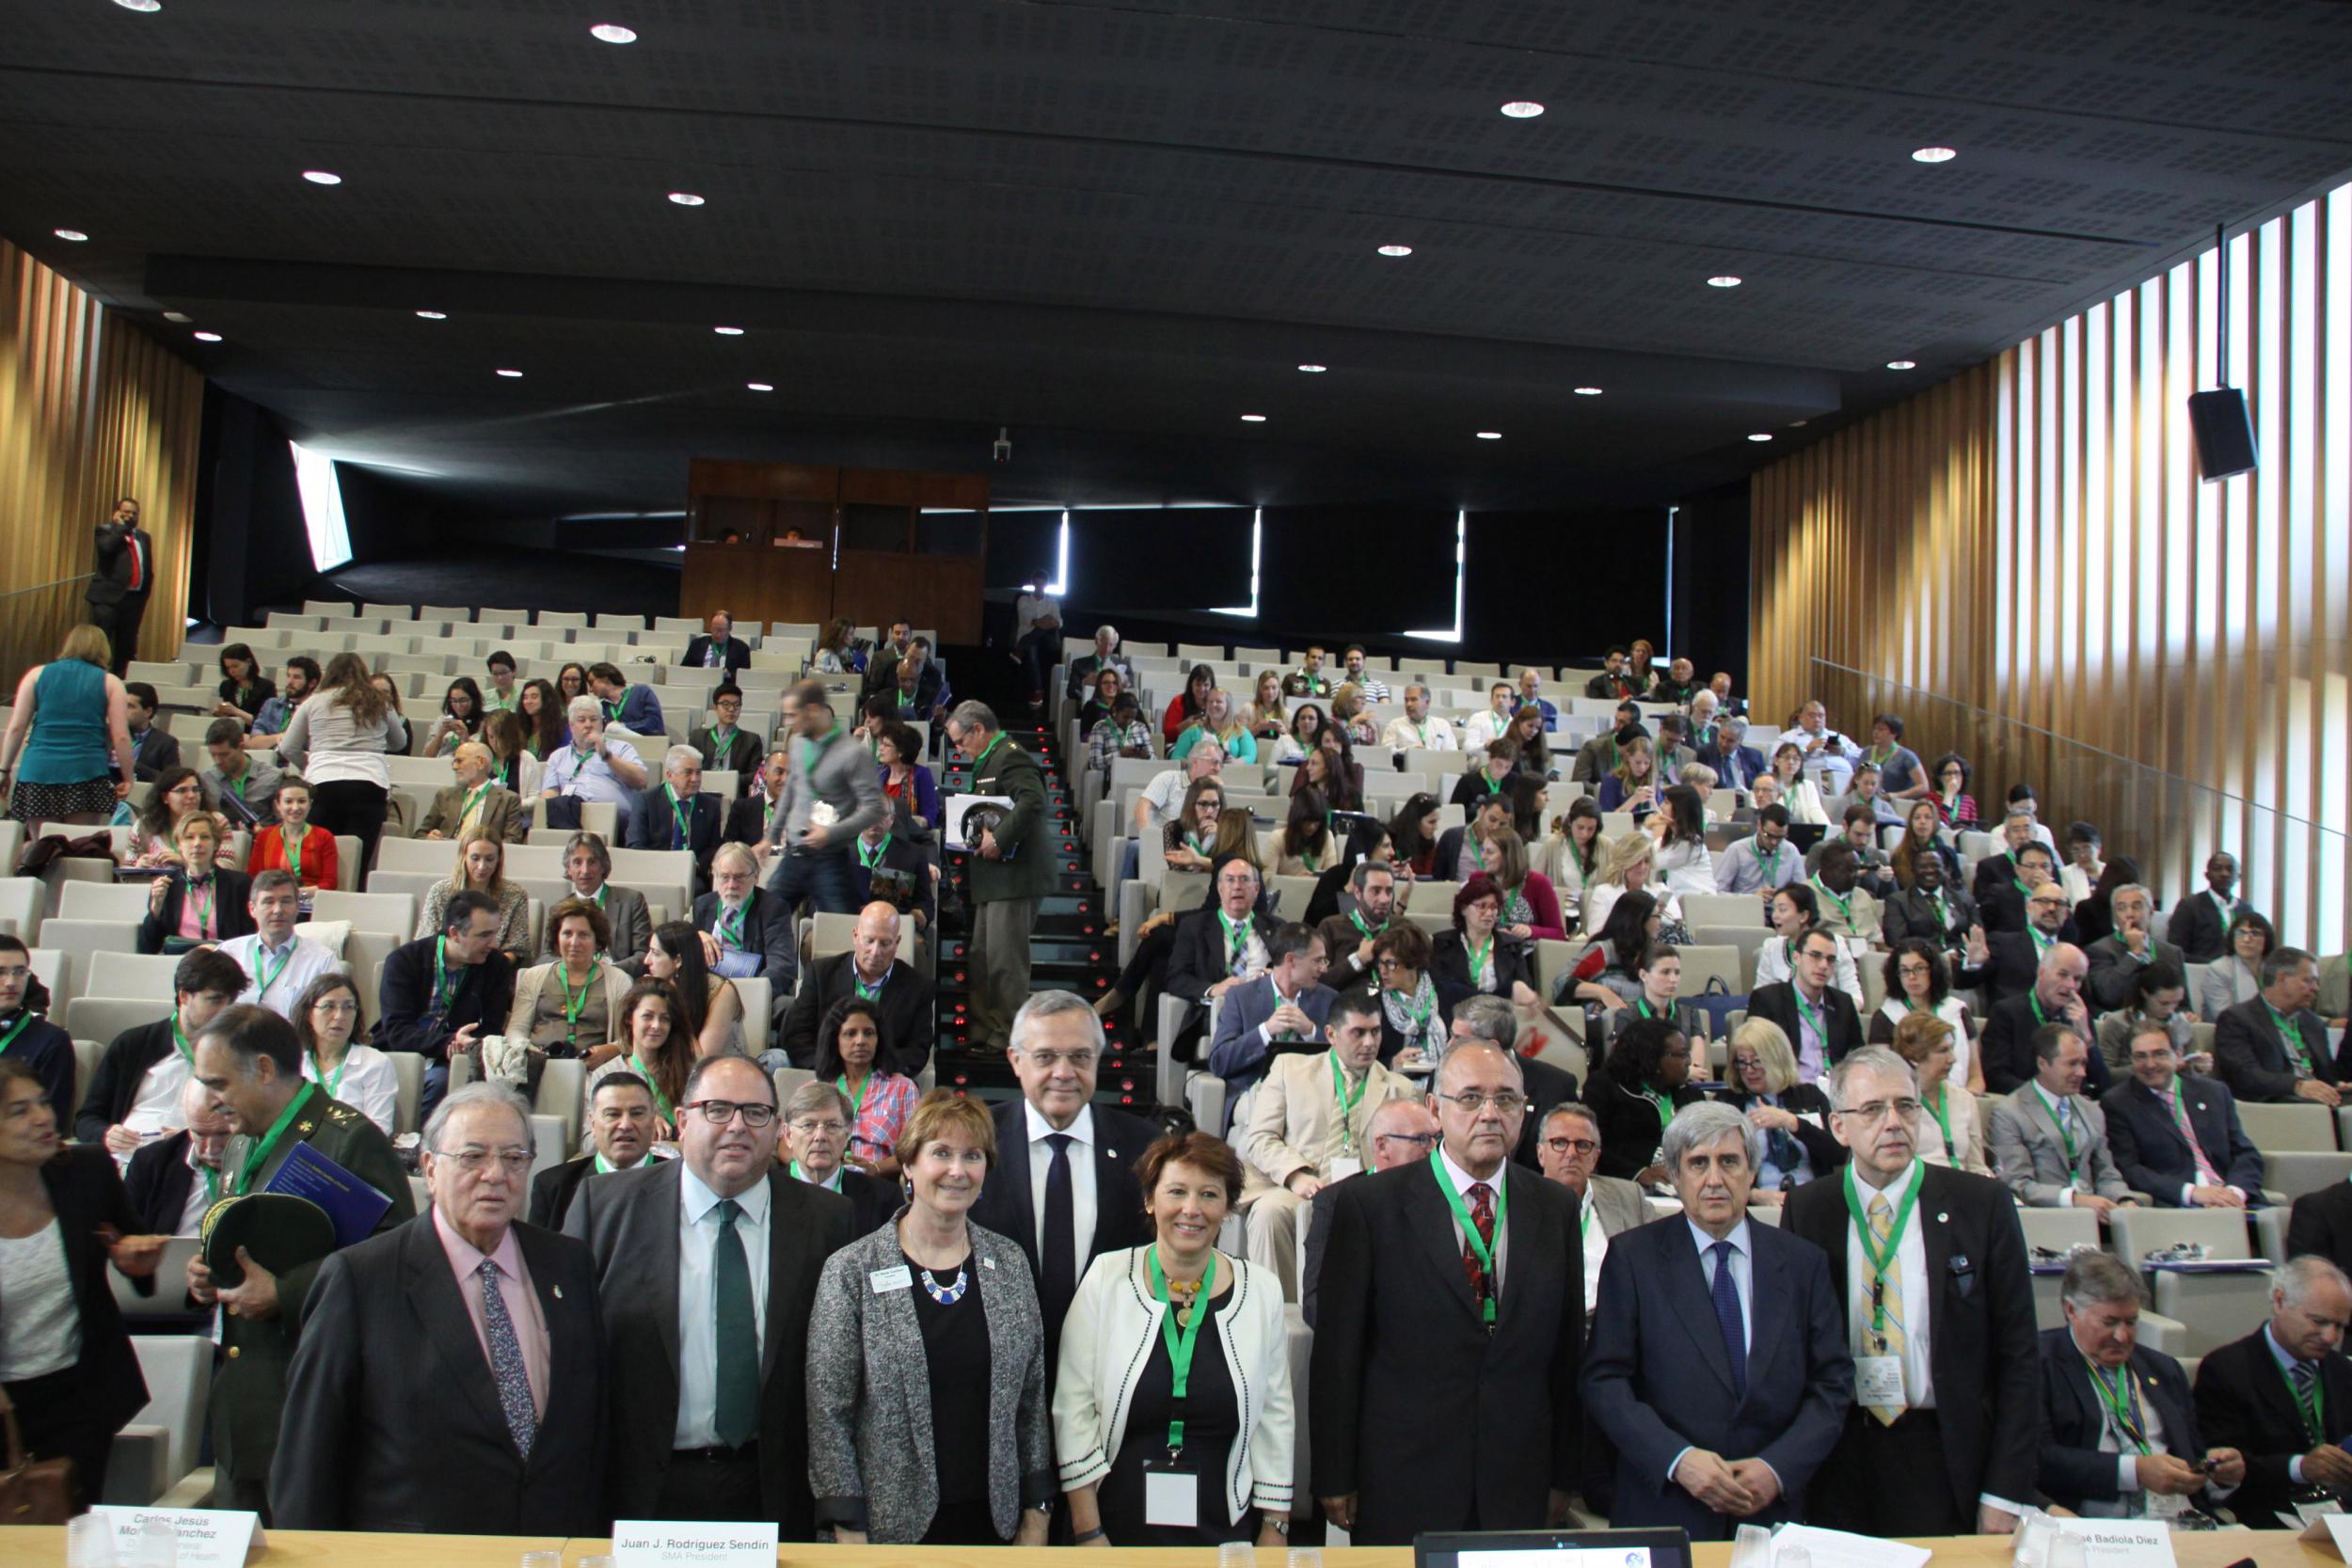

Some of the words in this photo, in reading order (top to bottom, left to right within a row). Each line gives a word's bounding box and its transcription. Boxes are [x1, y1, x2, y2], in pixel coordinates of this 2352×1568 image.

[621, 1538, 650, 1548] Juan
[653, 1538, 663, 1548] J.
[2094, 1534, 2134, 1544] Badiola
[661, 1550, 682, 1560] SMA
[685, 1551, 728, 1561] President
